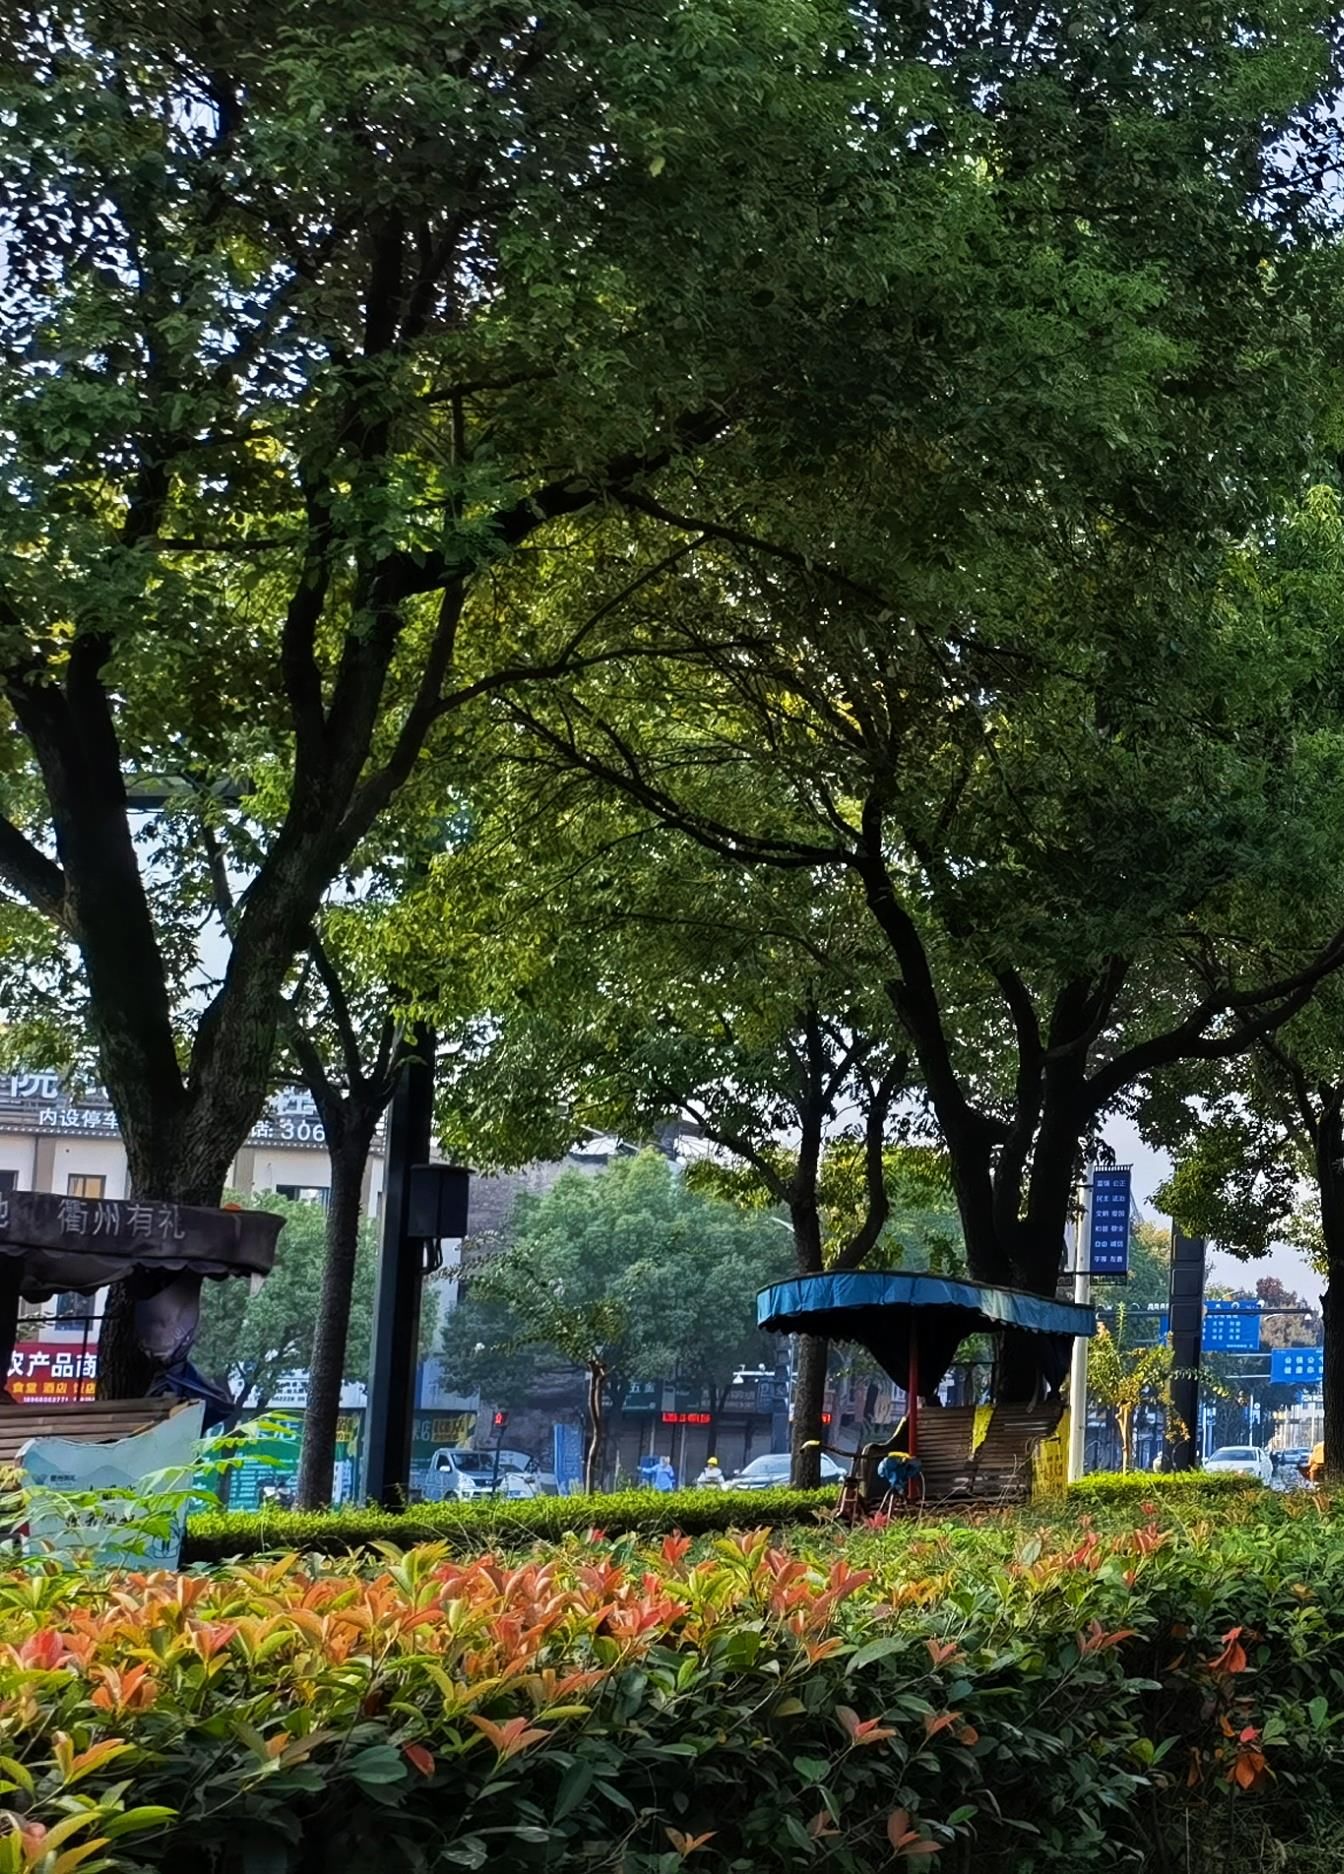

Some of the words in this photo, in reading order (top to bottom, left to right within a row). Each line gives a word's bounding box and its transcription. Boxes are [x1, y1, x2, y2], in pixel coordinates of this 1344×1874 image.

[39, 1108, 119, 1129] 内设停车
[57, 1199, 186, 1240] 衢州有礼
